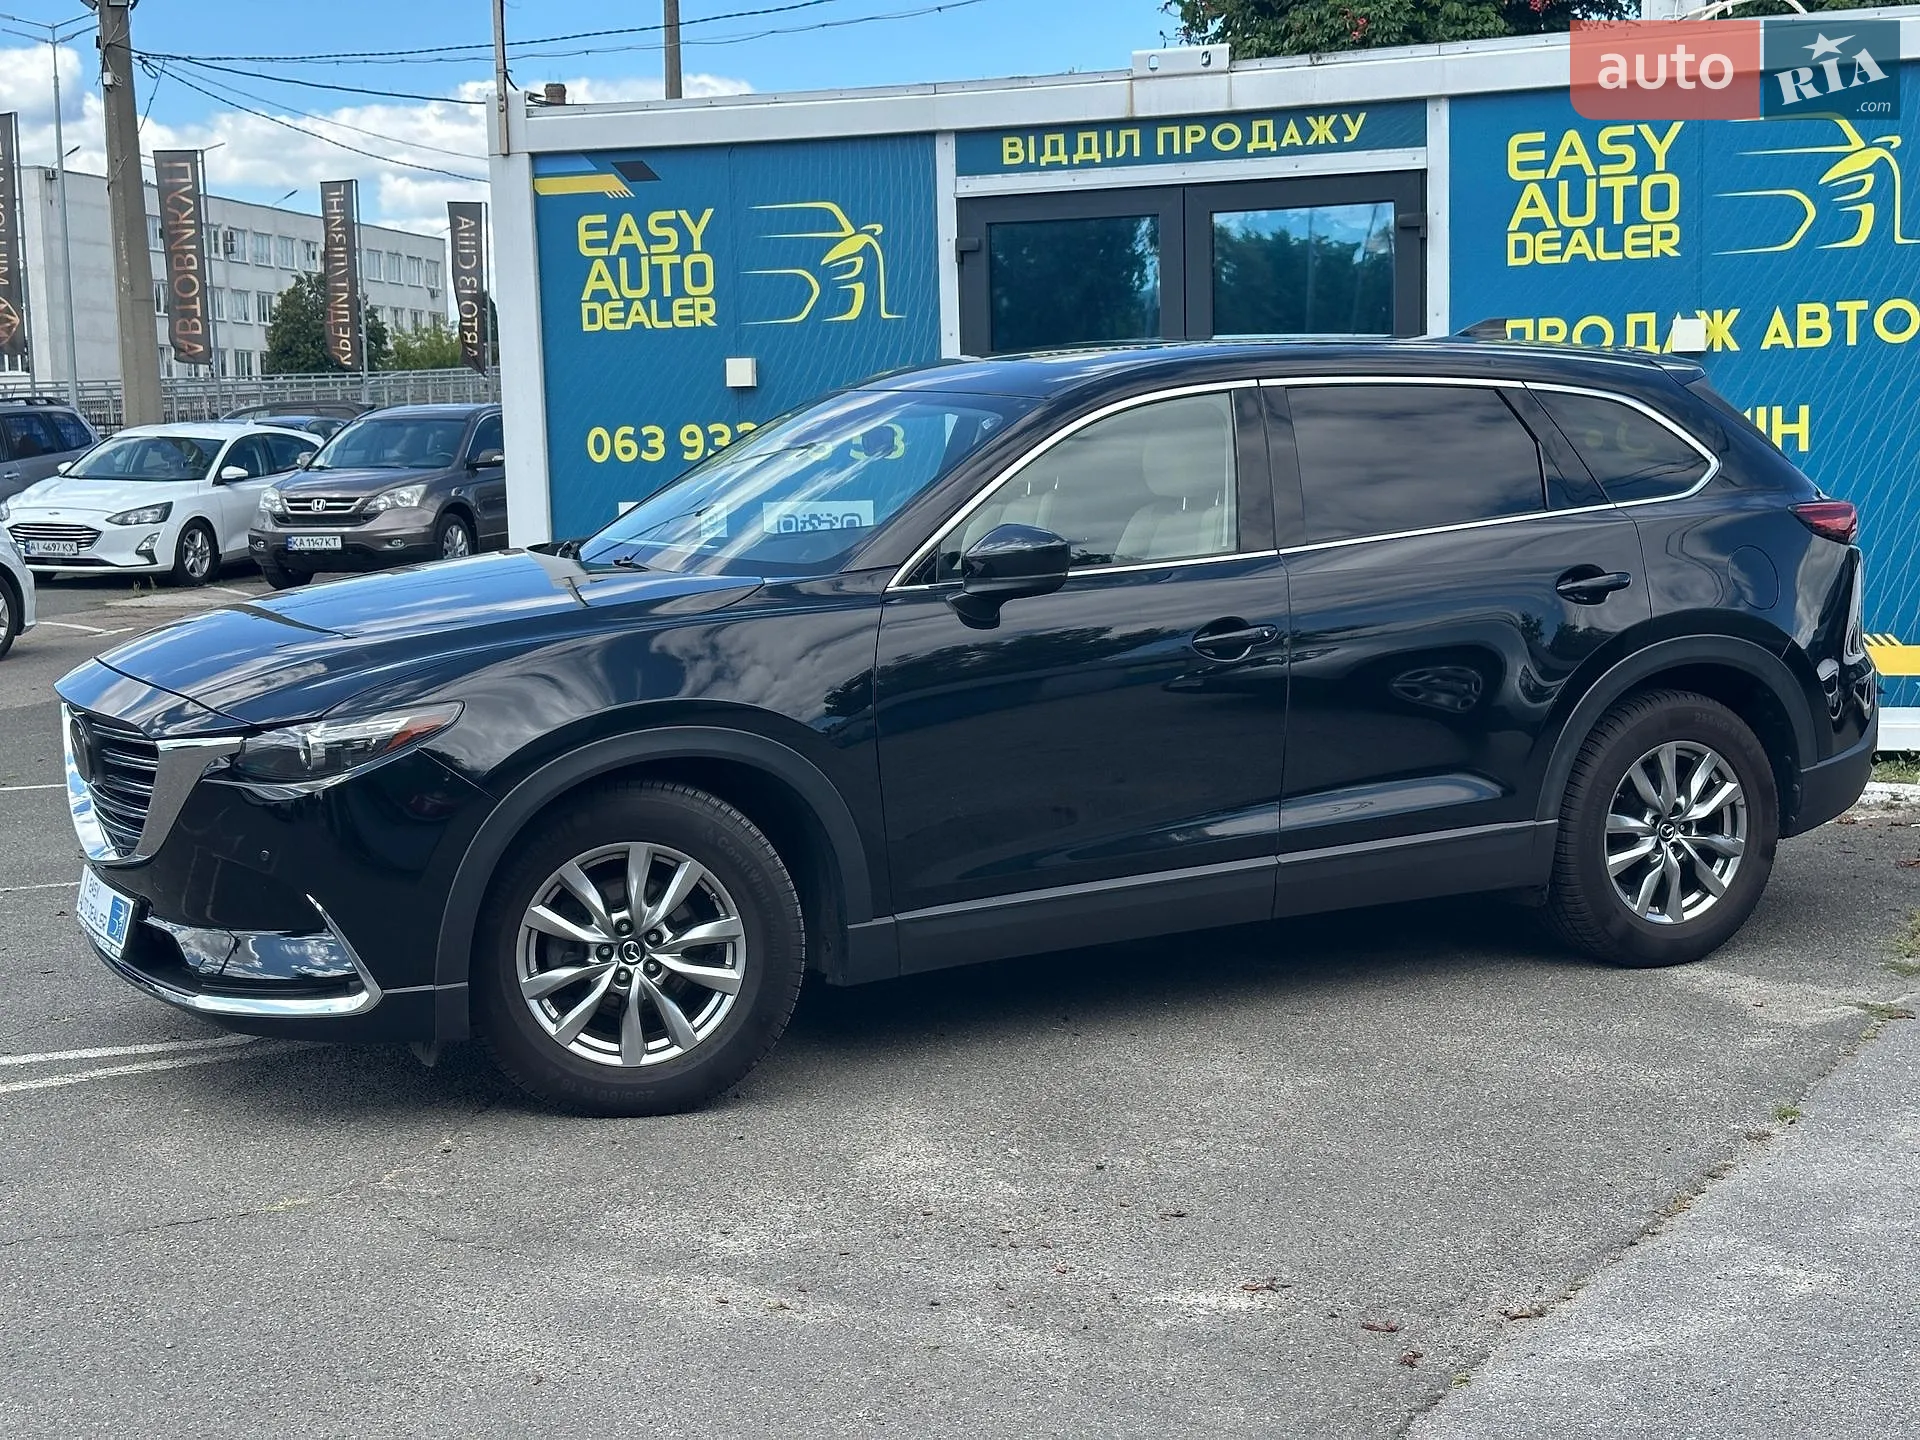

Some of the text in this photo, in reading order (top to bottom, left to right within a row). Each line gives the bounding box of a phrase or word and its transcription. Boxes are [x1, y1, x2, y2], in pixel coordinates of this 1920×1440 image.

[1002, 112, 1368, 167] ВІДДІЛ ПРОДАЖУ
[1507, 121, 1685, 181] EASY
[1507, 173, 1680, 231] AUTO
[577, 208, 714, 257] EASY
[1507, 223, 1681, 267] DEALER
[581, 253, 714, 300] AUTO
[581, 297, 718, 331] DEALER
[1506, 298, 1920, 354] ПРОДЖ АВТО
[587, 425, 666, 463] 063
[680, 422, 758, 461] 93
